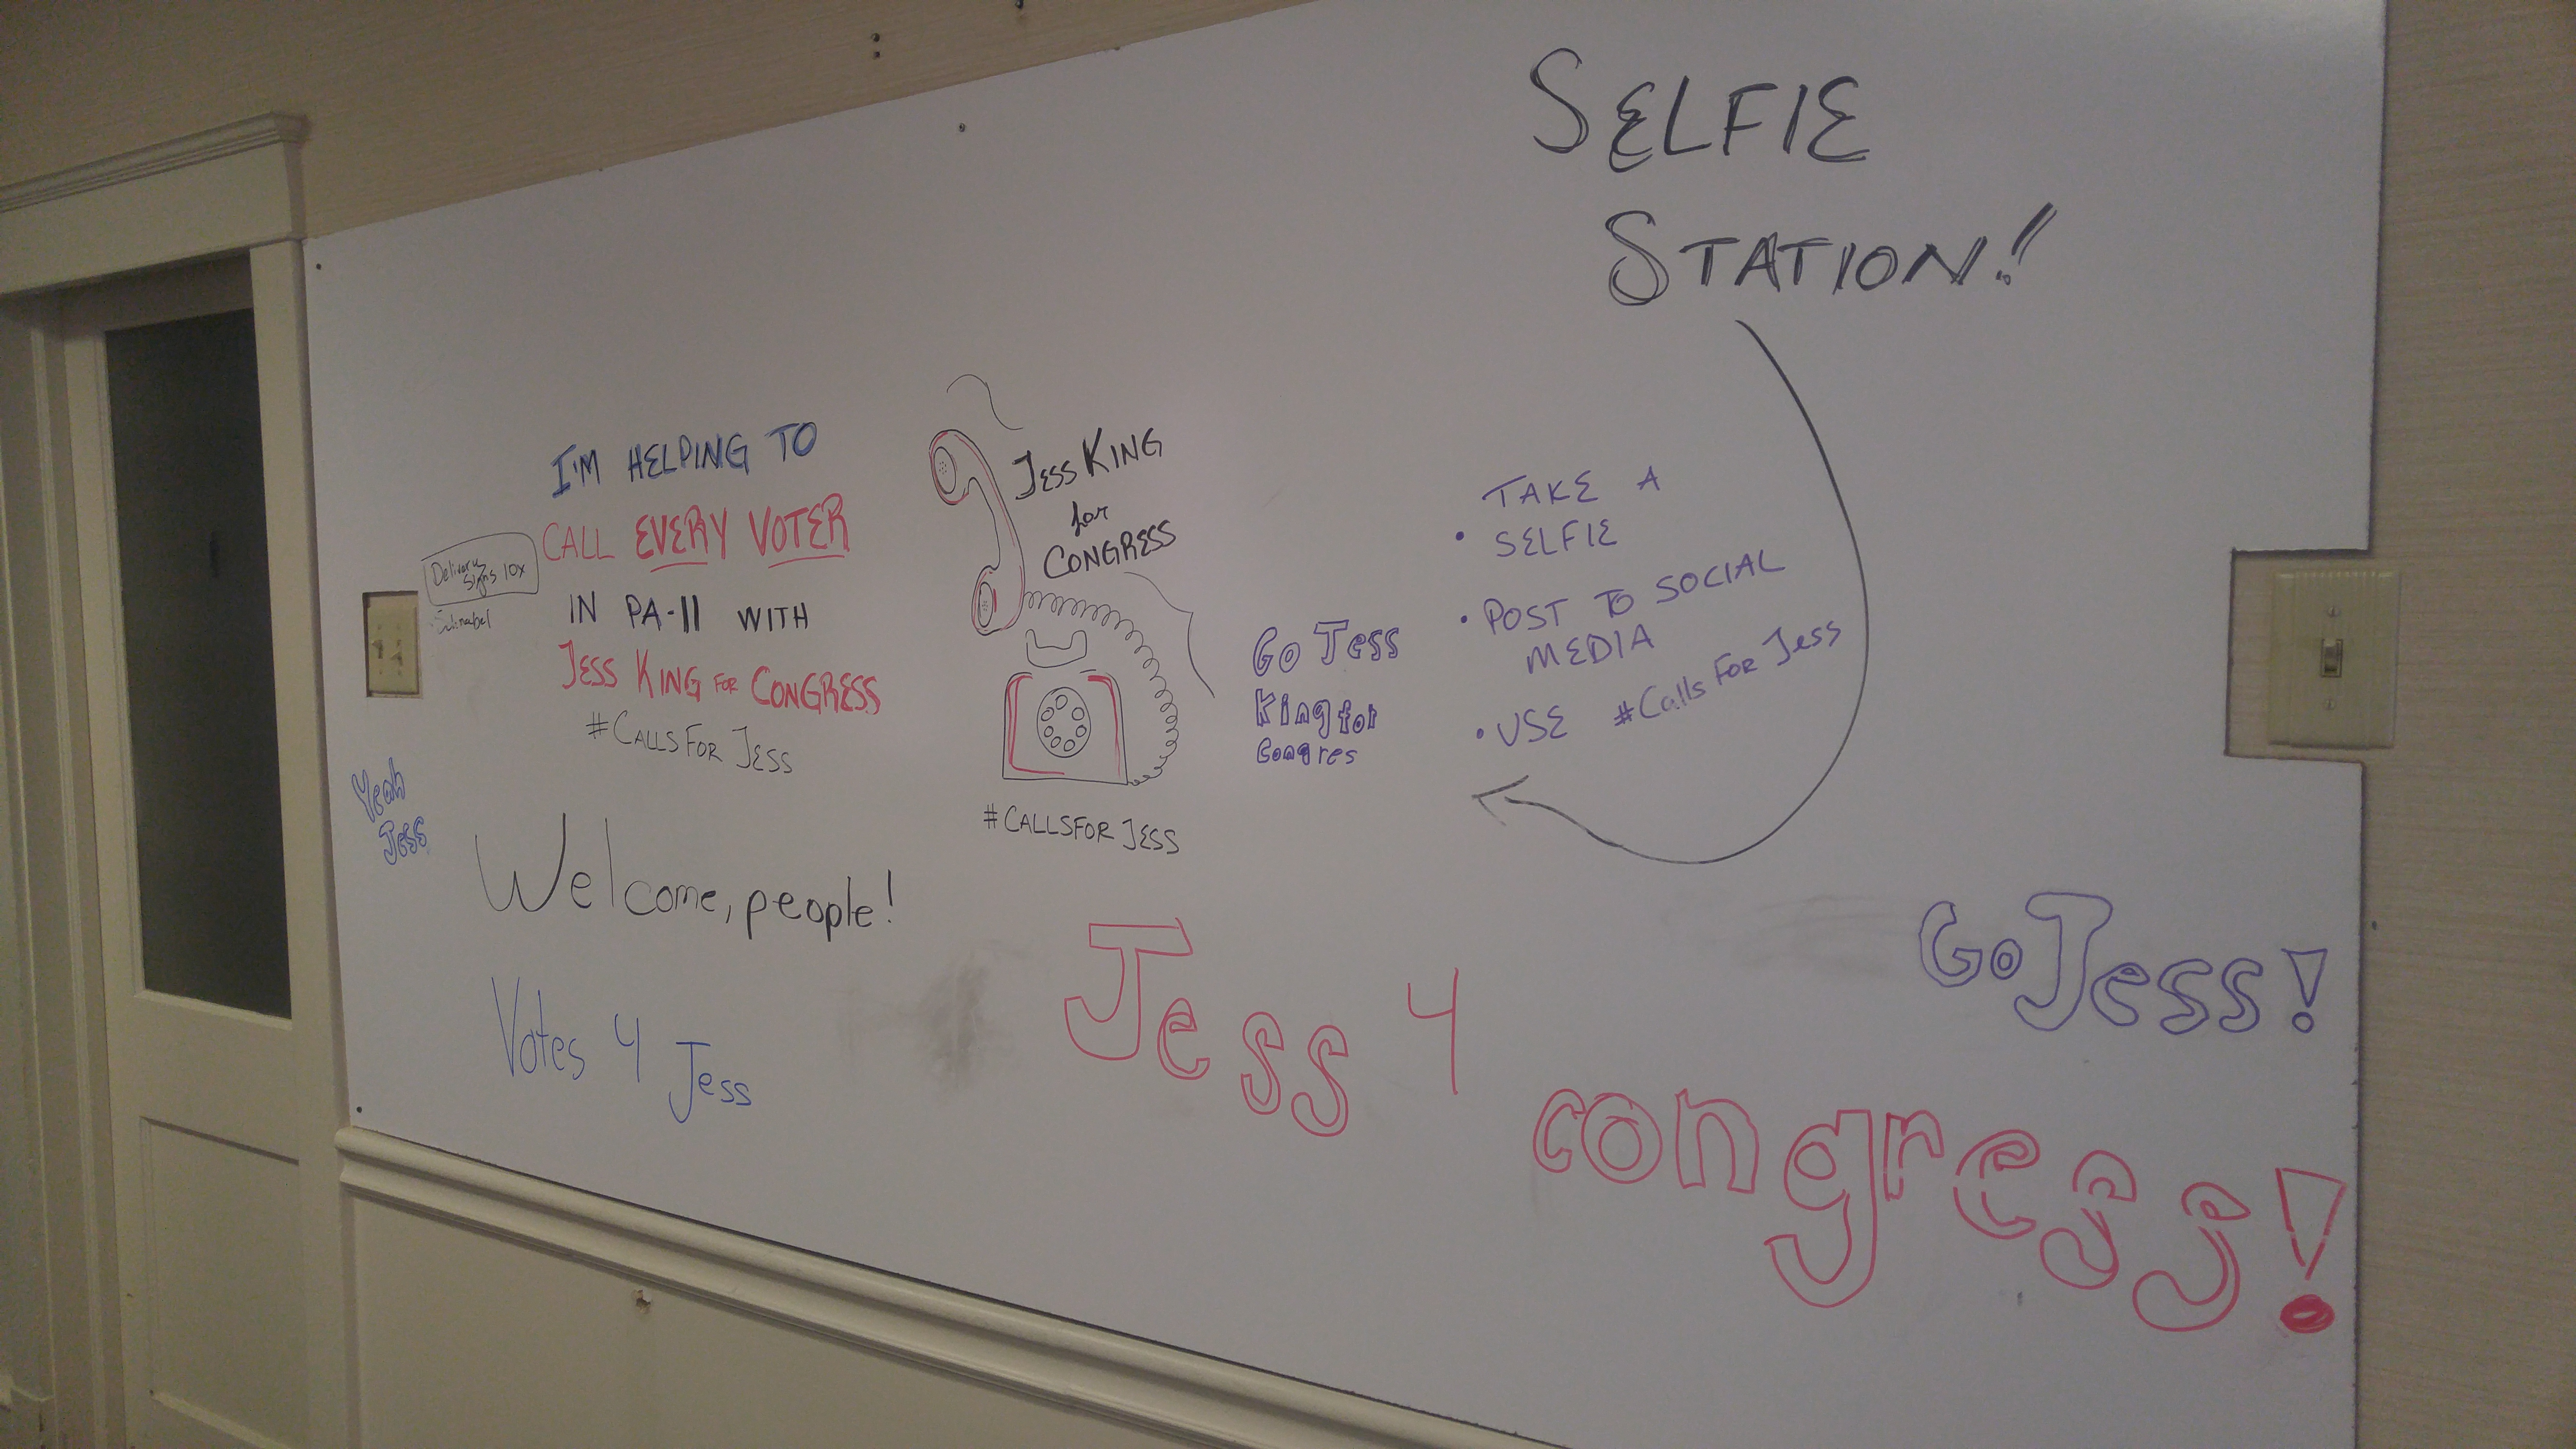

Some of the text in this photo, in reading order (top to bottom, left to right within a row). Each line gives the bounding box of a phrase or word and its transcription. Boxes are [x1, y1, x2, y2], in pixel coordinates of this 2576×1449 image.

[1529, 47, 1870, 174] SELFIE
[1604, 202, 2058, 306] STATION!
[550, 421, 818, 499] I'M HELPING TO
[1481, 465, 1660, 508] TAKE A
[542, 492, 850, 562] CALL EVERY VOTER
[1043, 518, 1177, 580] CONGRESS
[1071, 500, 1109, 537] for
[1495, 518, 1618, 558] SELFIE
[570, 590, 597, 624] IN
[737, 602, 808, 632] WITH
[1483, 549, 1786, 635] POST TO SOCIAL
[1313, 618, 1400, 666] Jess
[1526, 622, 1655, 675] MEDIA
[636, 648, 701, 702] KING
[751, 665, 881, 715] CONGRESS
[1497, 704, 1568, 747] USE
[351, 757, 405, 823] Yeah
[474, 812, 893, 943] Welcome, people!
[491, 976, 752, 1124] Votes 4 Jess
[1064, 917, 1460, 1138] Jess 4
[1532, 1088, 2347, 1335] congress!
